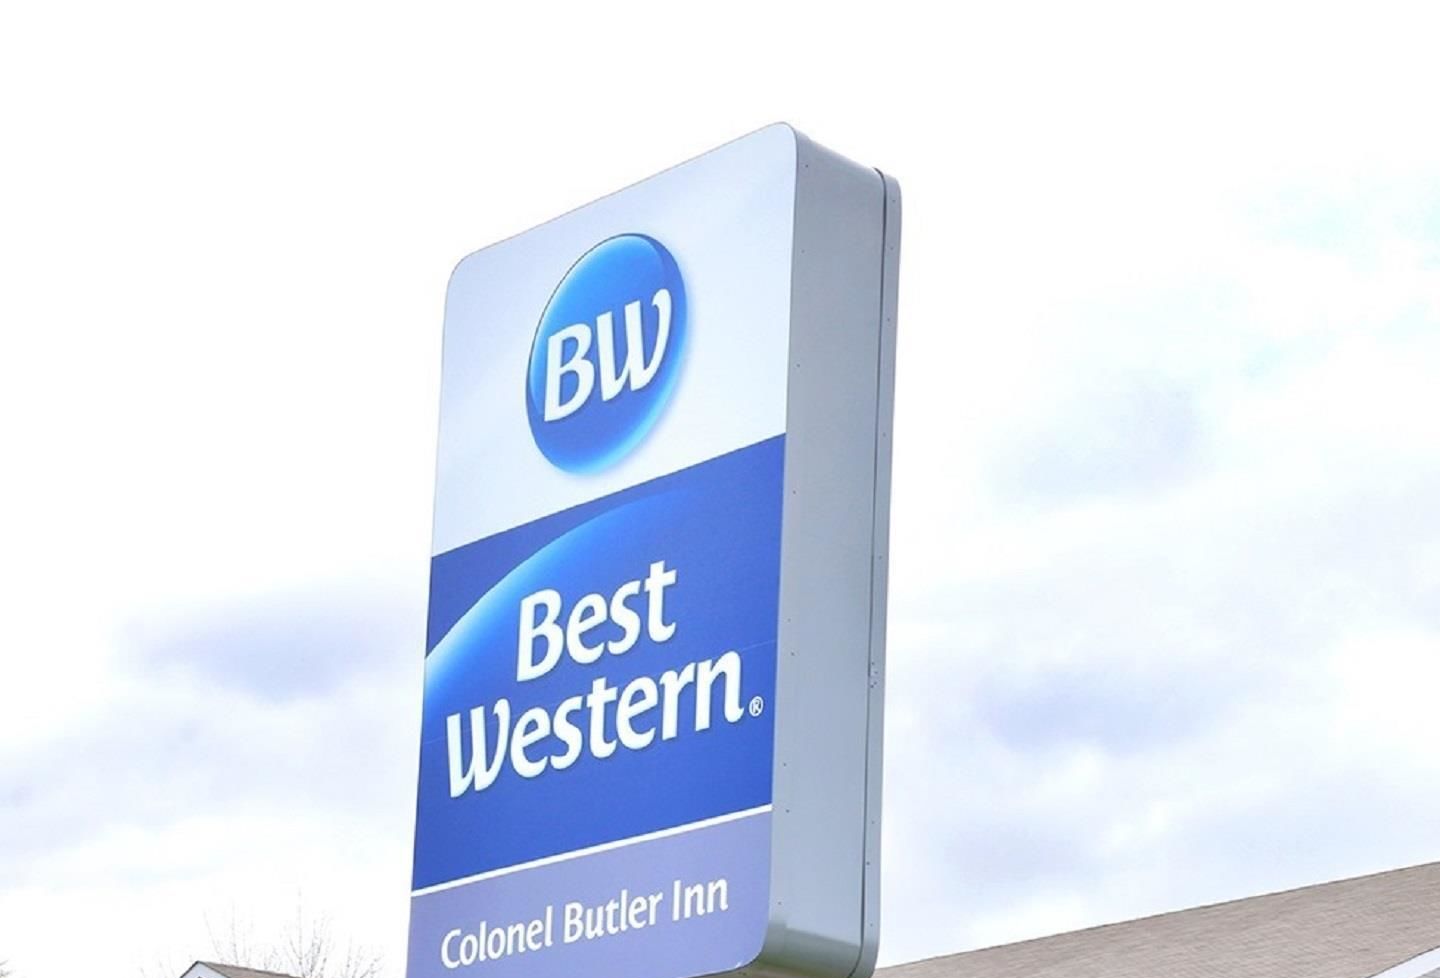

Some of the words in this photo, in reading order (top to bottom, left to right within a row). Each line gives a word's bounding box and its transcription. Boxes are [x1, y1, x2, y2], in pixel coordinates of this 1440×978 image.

[544, 289, 671, 421] BW
[516, 561, 677, 682] Best
[440, 905, 554, 969] Colonel
[563, 889, 664, 944] Butler
[672, 878, 729, 921] Inn
